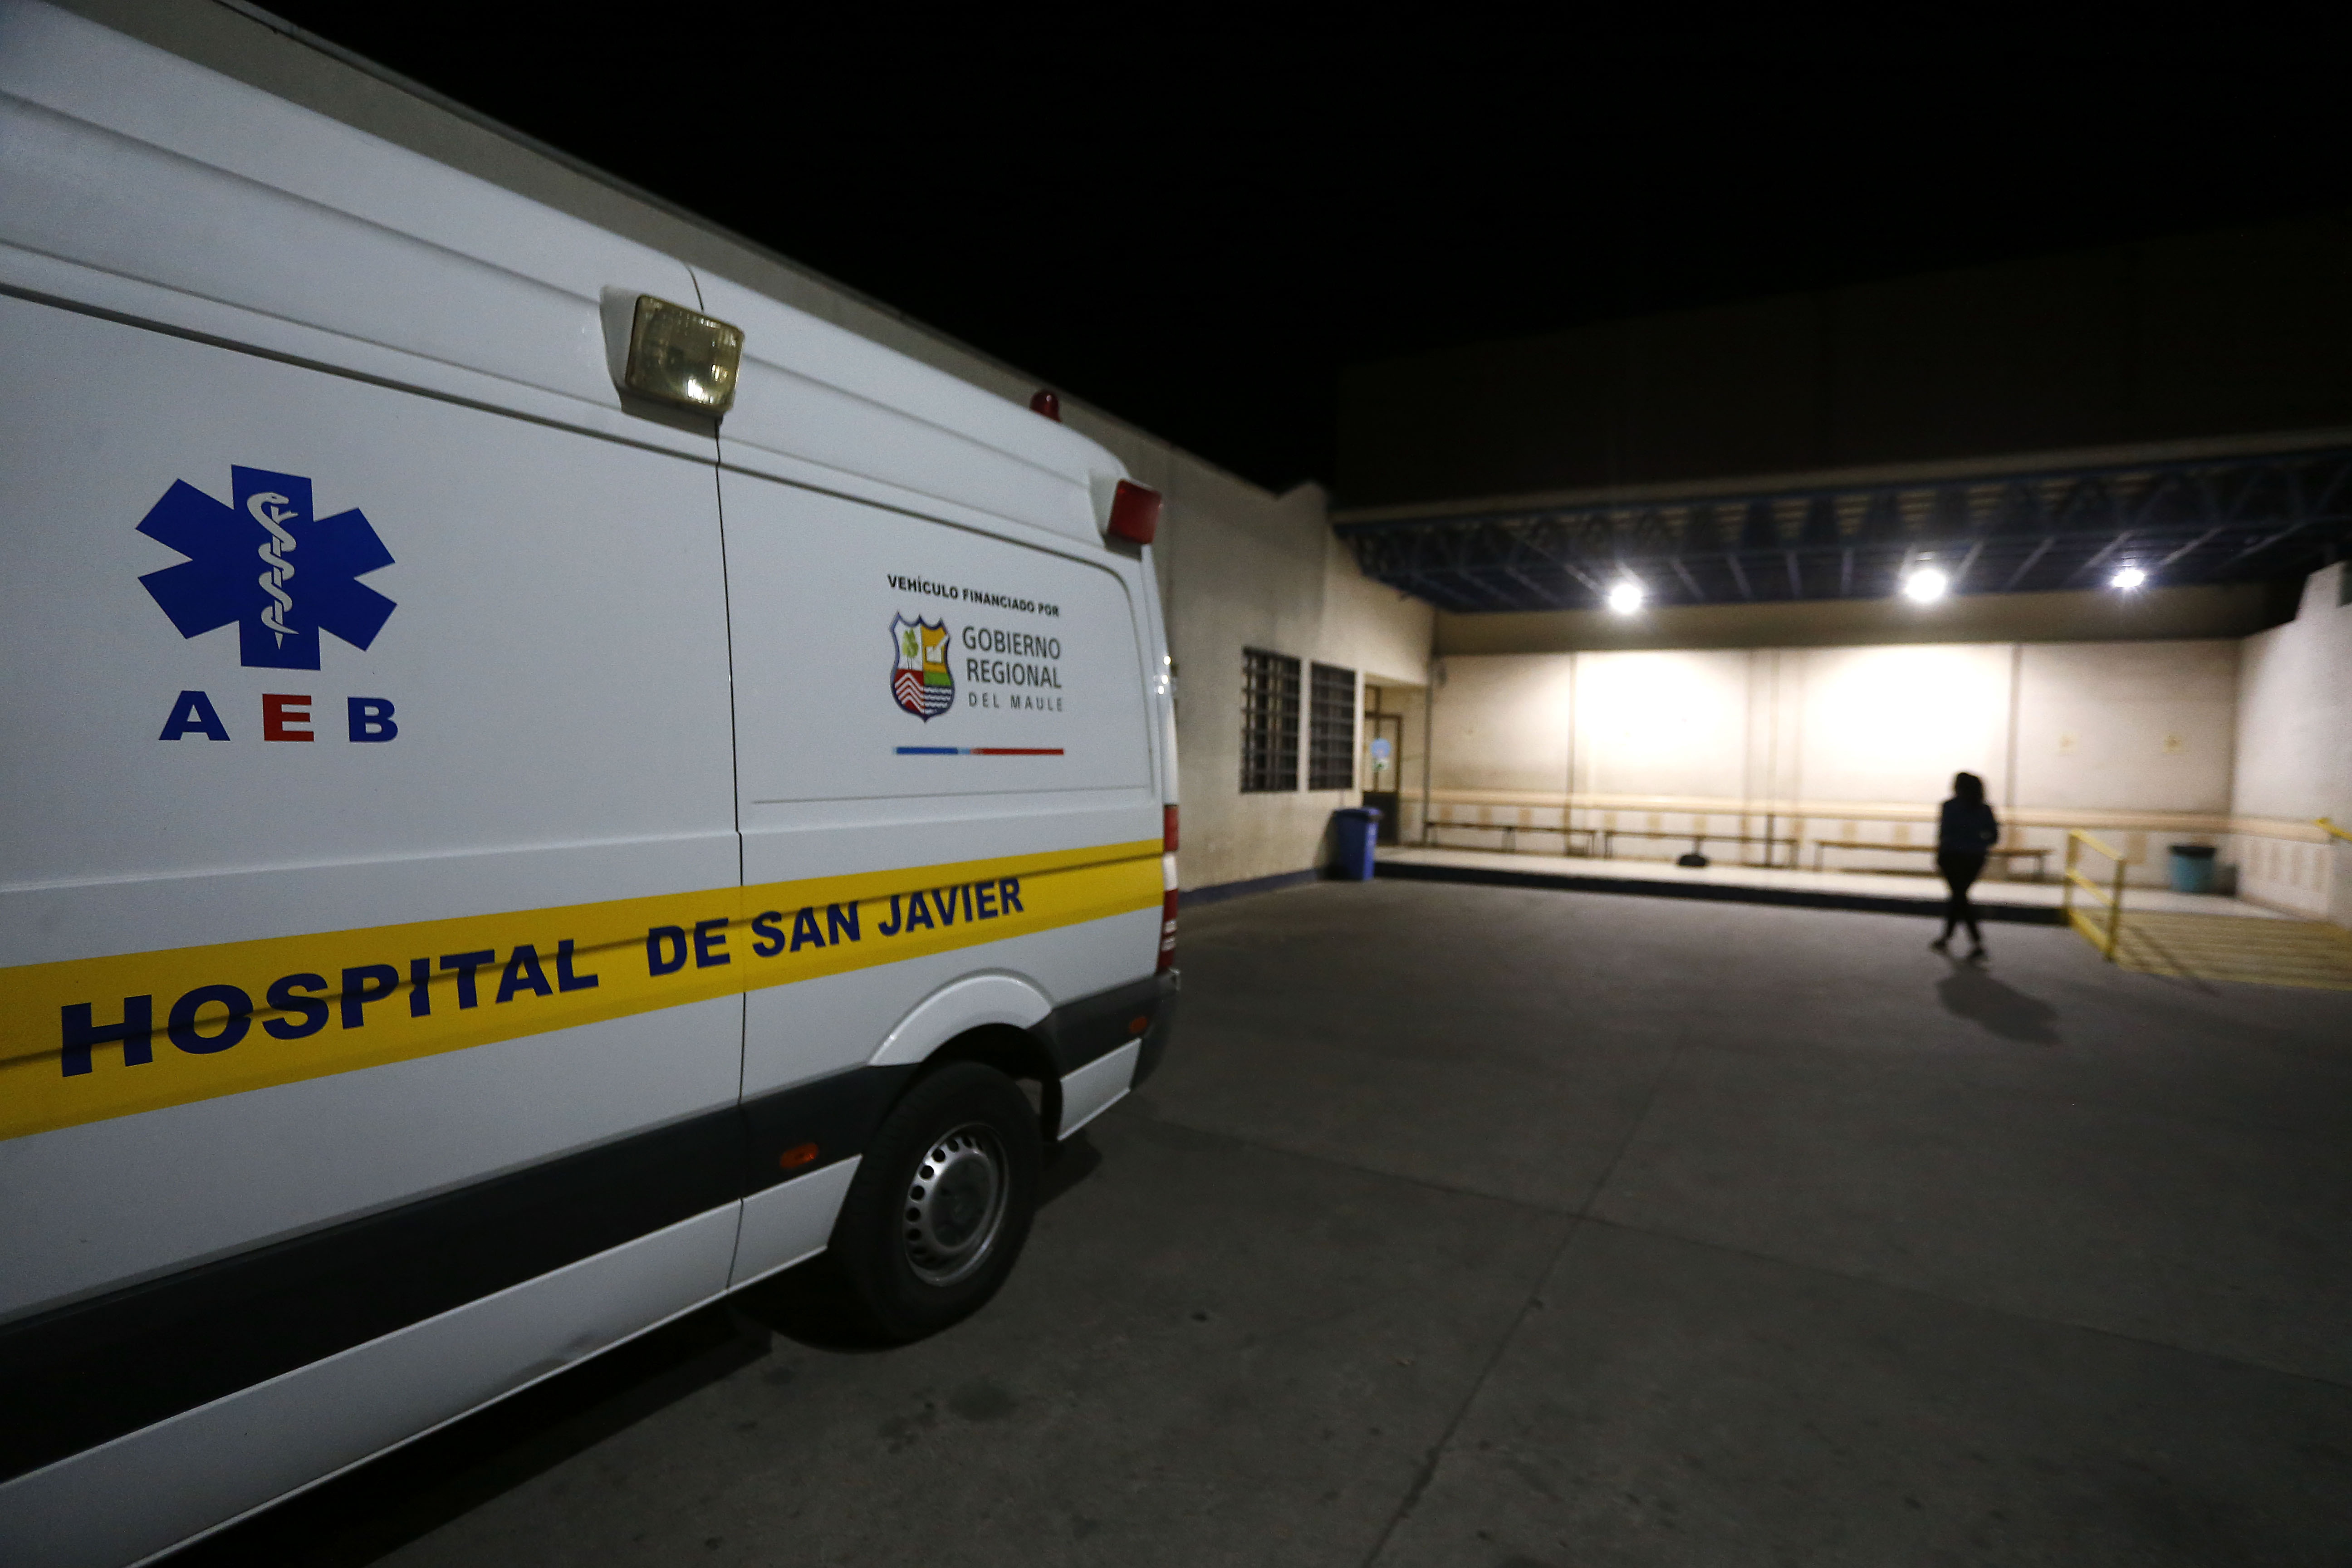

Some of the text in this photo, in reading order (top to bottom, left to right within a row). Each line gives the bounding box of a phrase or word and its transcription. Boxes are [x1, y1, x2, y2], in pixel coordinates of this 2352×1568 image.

[887, 574, 1060, 617] VEHÍCULO FINANCIADO POR
[962, 626, 1061, 660] GOBIERNO
[966, 657, 1062, 689] REGIONAL
[969, 692, 1063, 711] DEL MAULE
[61, 878, 1024, 1077] HOSPITAL DE SAN JAVIER
